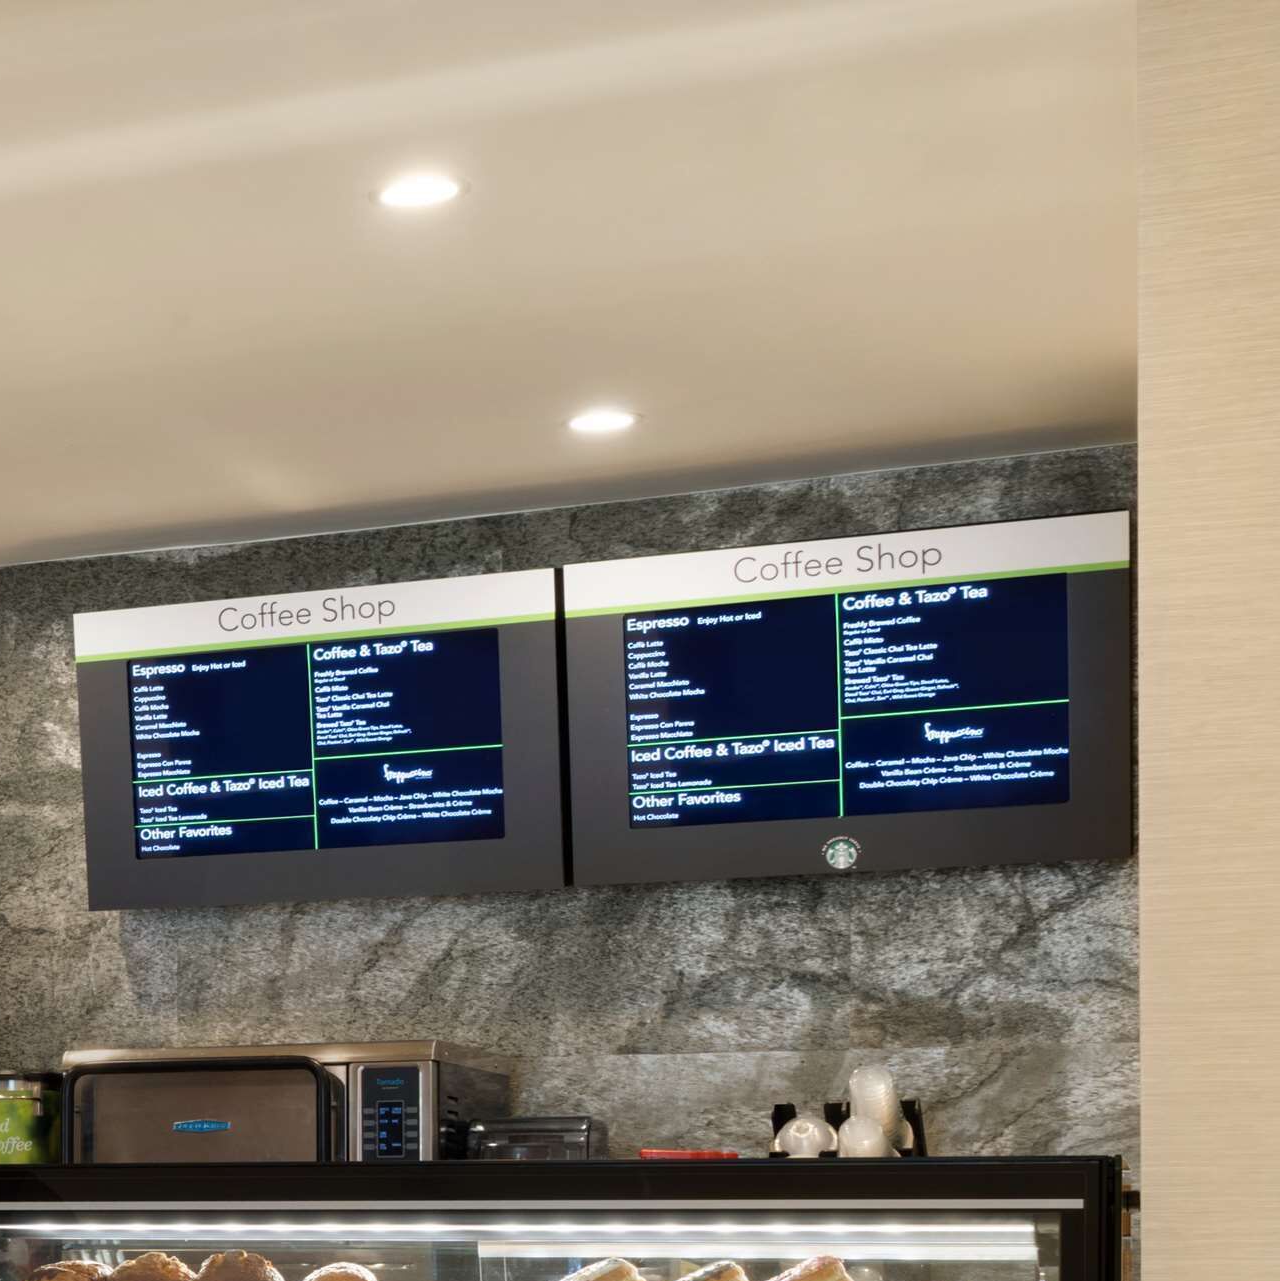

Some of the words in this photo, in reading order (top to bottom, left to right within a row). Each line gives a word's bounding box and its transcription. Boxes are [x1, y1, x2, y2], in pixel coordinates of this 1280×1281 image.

[734, 550, 843, 584] Coffee
[856, 543, 942, 575] Shop
[842, 594, 894, 611] Coffee
[898, 592, 912, 605] &
[959, 585, 988, 599] Tea
[218, 601, 311, 632] Coffee
[322, 595, 396, 625] Shop
[697, 617, 718, 626] Enjoy
[744, 612, 762, 620] Iced
[626, 616, 690, 633] Espresso
[313, 646, 356, 660] Coffee
[359, 645, 371, 657] &
[410, 639, 434, 652] Tea
[132, 664, 186, 678] Espresso
[631, 749, 660, 762] Iced
[664, 744, 712, 760] Coffee
[716, 743, 728, 756] &
[774, 738, 805, 752] Iced
[808, 736, 835, 749] Tea
[138, 786, 164, 797] Iced
[166, 782, 207, 795] Coffee
[210, 781, 221, 793] &
[258, 777, 284, 790] Iced
[286, 775, 310, 787] Tea
[632, 795, 674, 808] Other
[678, 791, 741, 805] Favorites
[141, 828, 175, 840] Other
[179, 825, 232, 838] Favorites
